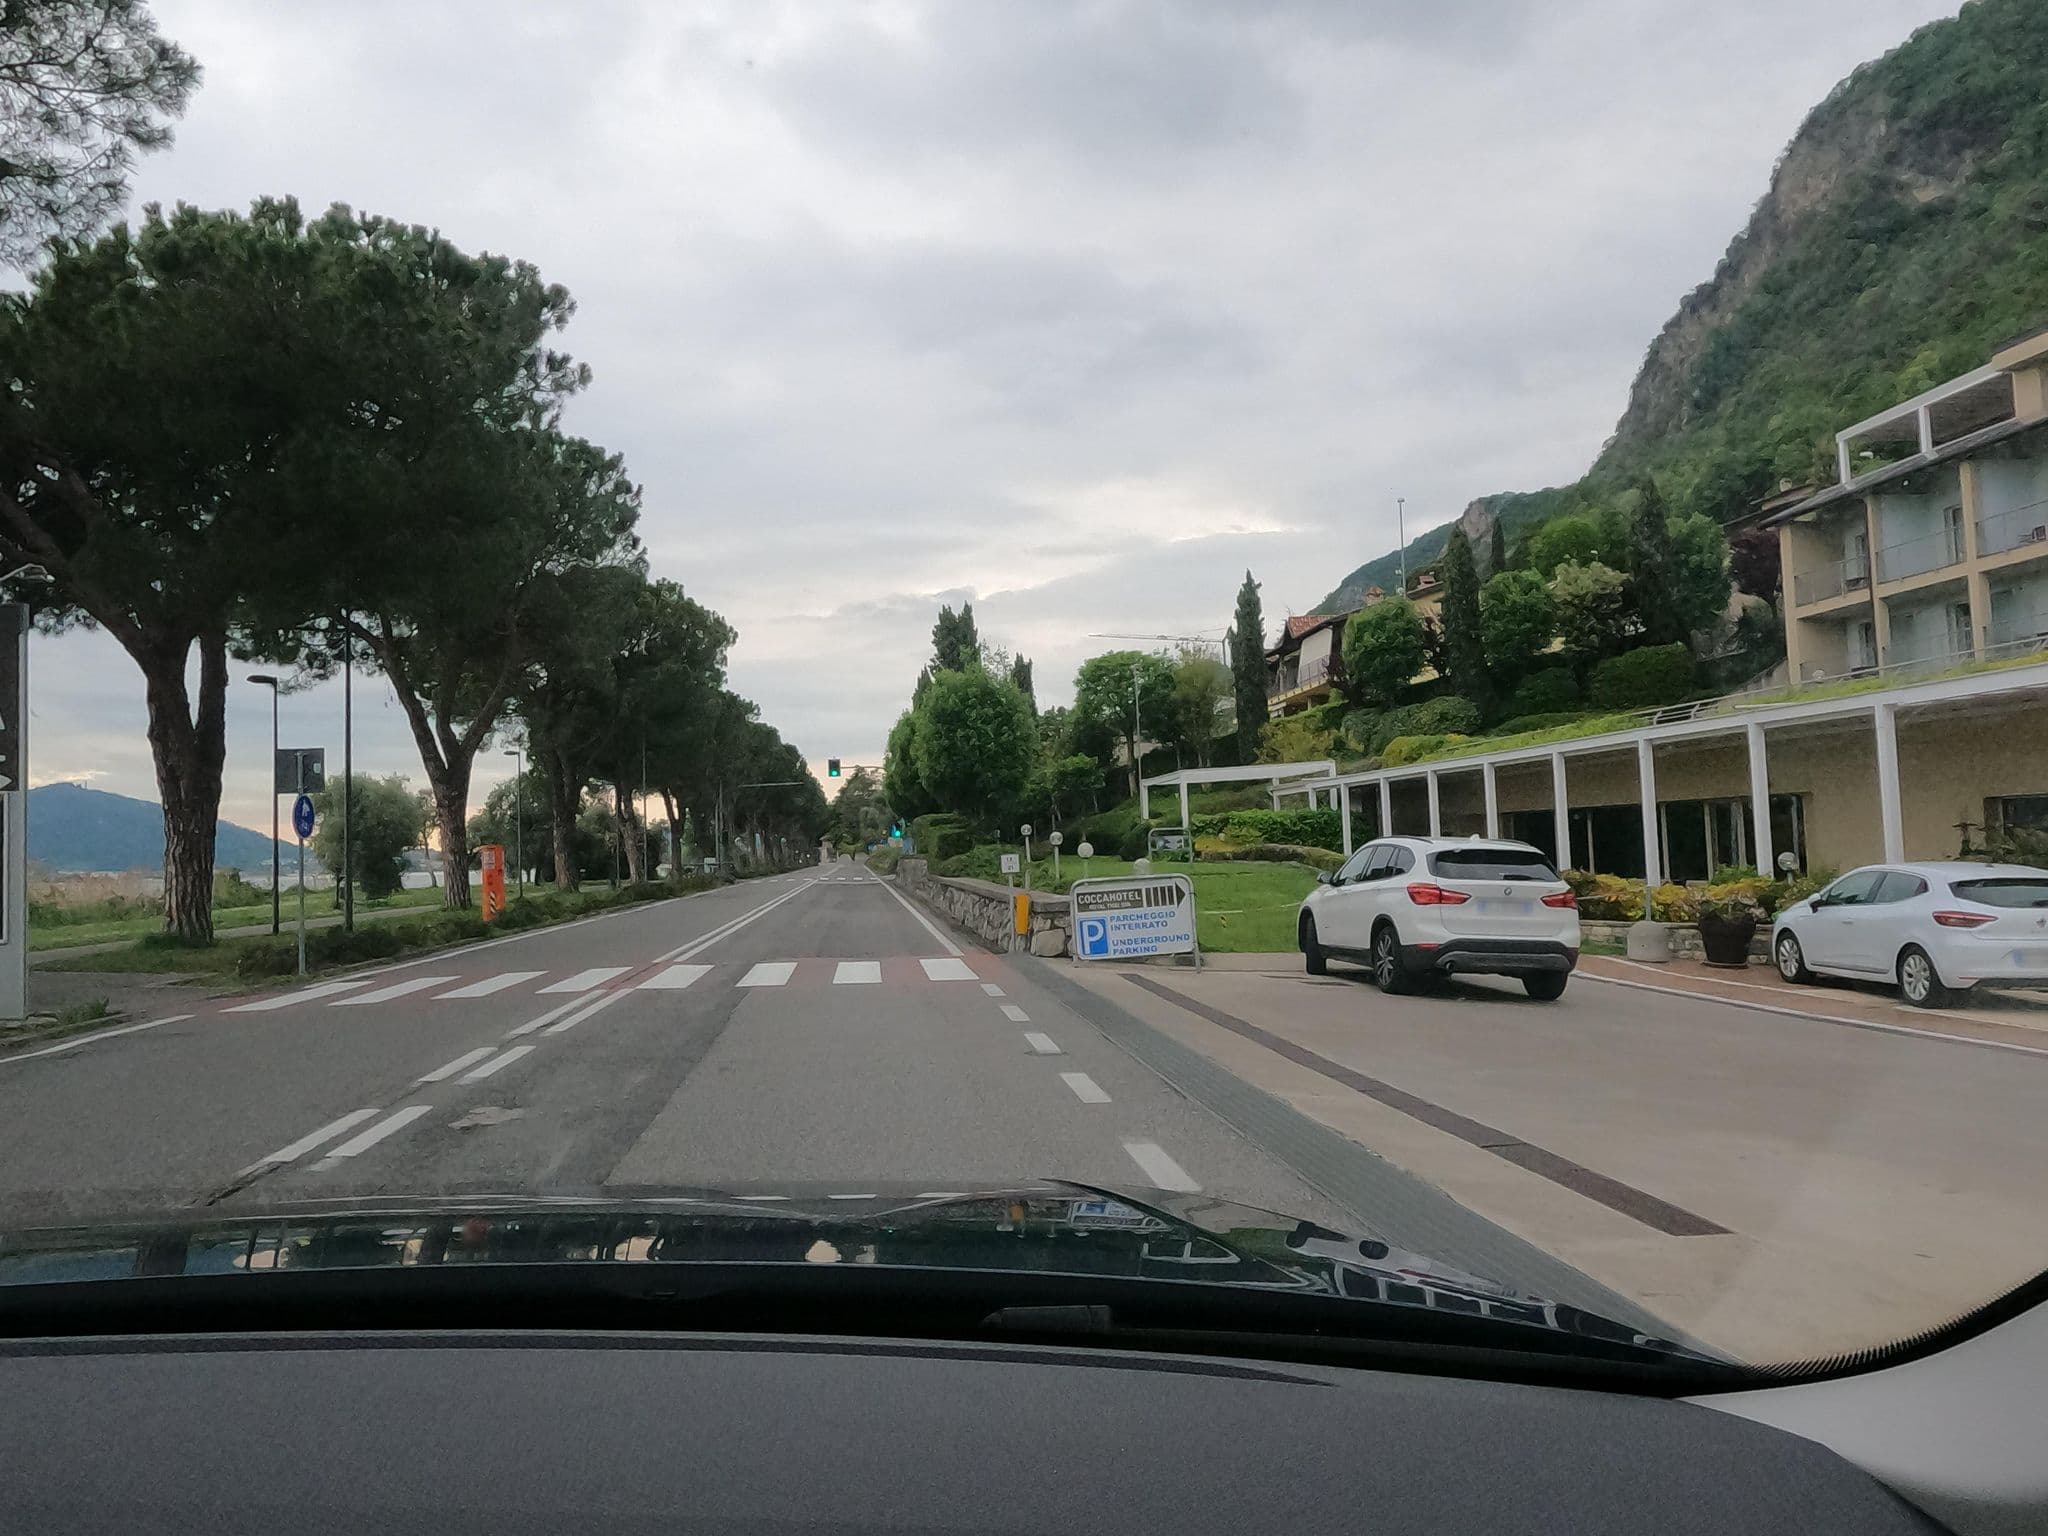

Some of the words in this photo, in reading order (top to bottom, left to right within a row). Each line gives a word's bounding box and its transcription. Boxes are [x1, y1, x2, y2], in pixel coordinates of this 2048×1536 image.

[1078, 891, 1142, 904] COCCAHOTEL
[1109, 911, 1176, 923] PARCHEGGIO
[1110, 920, 1168, 931] INTERRATO
[1082, 920, 1104, 955] P
[1112, 933, 1190, 947] UNDERGROUND
[1113, 945, 1158, 956] PARKING
